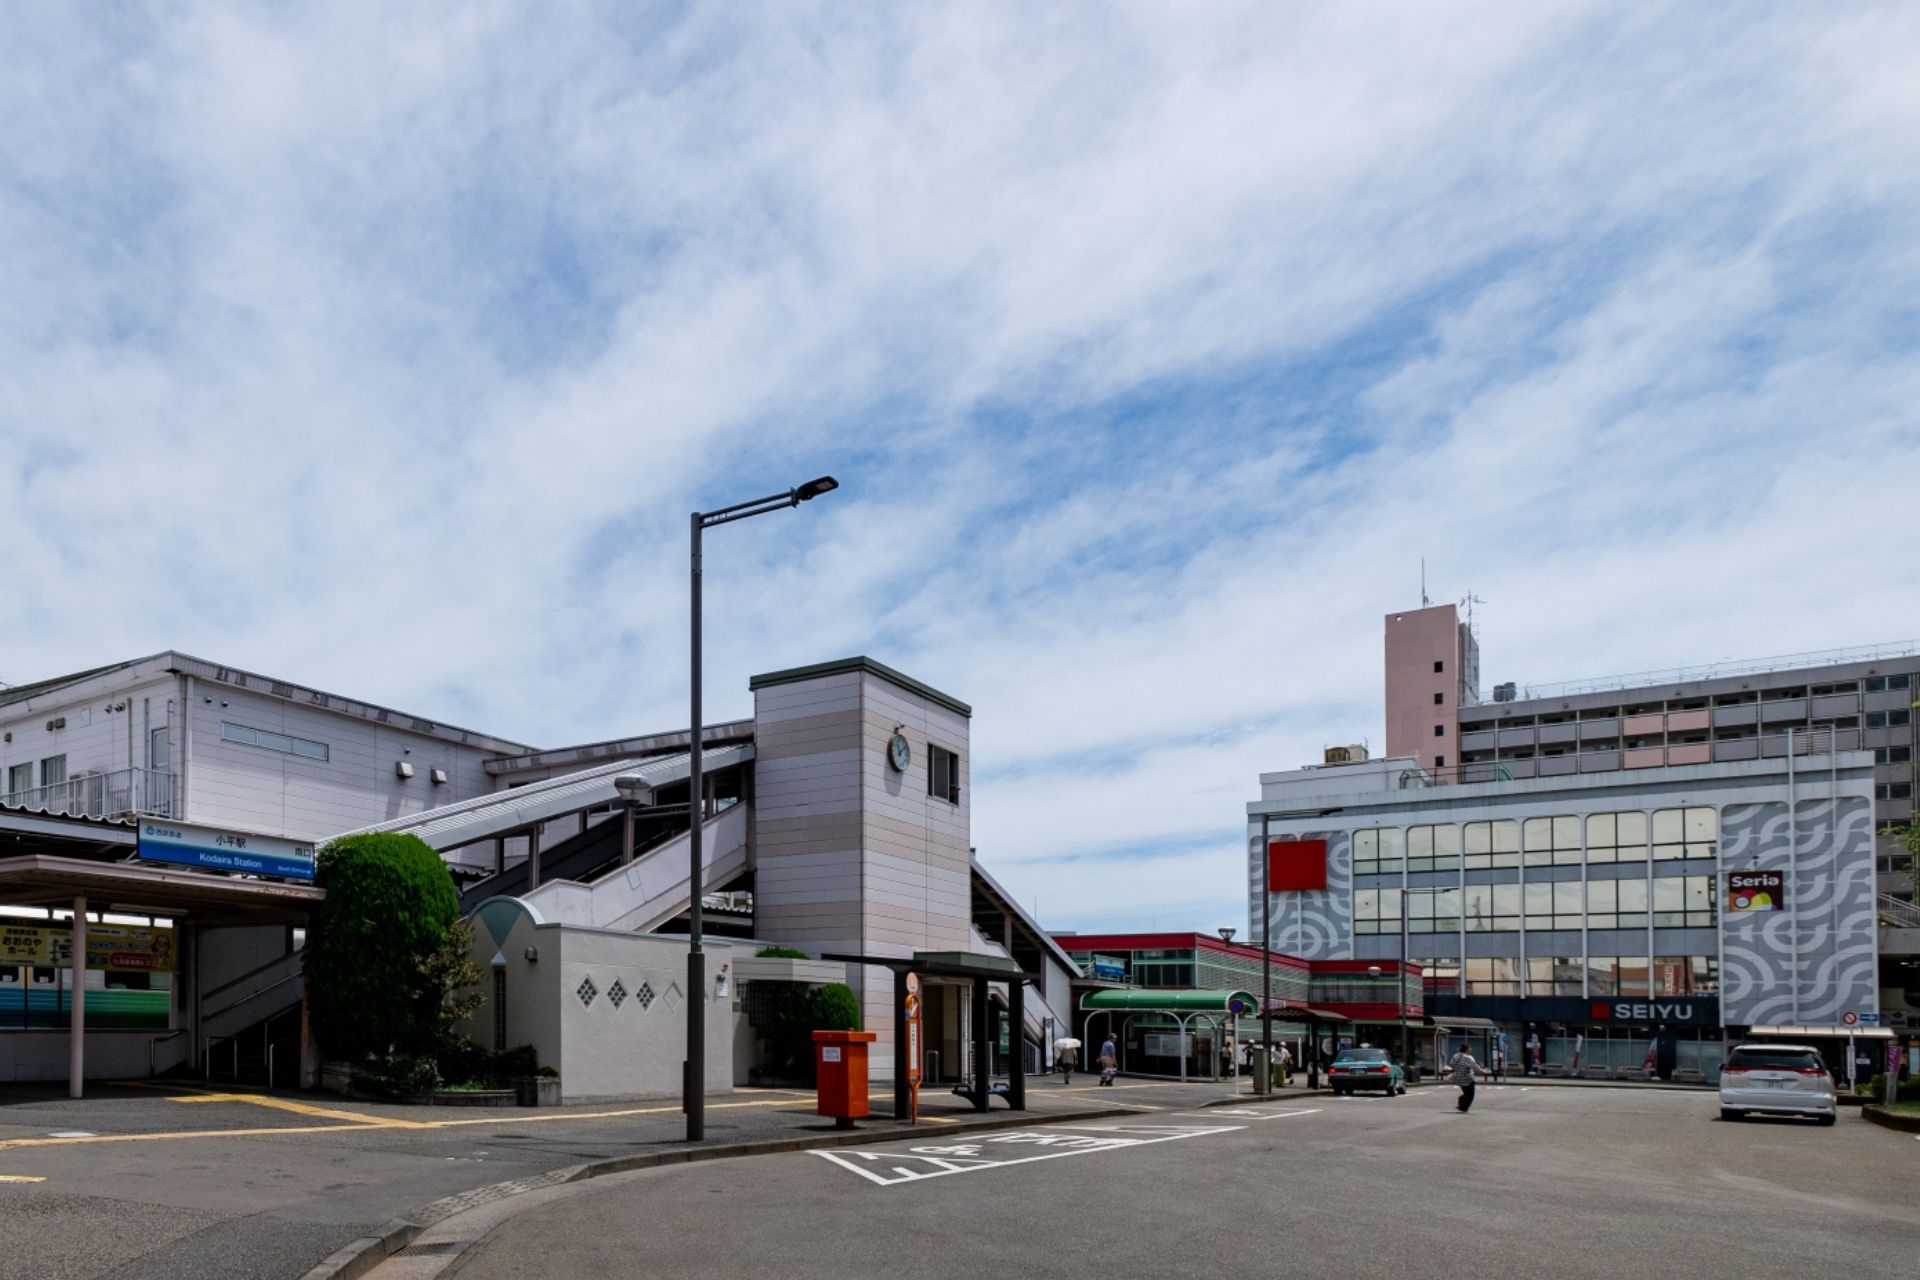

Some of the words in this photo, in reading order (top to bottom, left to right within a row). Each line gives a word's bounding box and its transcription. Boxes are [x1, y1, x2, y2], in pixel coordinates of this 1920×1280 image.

[215, 833, 247, 849] 小平駅
[199, 852, 232, 865] Kodaira
[233, 857, 263, 869] Station
[1731, 874, 1780, 888] Seria
[8, 946, 37, 956] ホール
[1614, 1003, 1692, 1020] SEIYU
